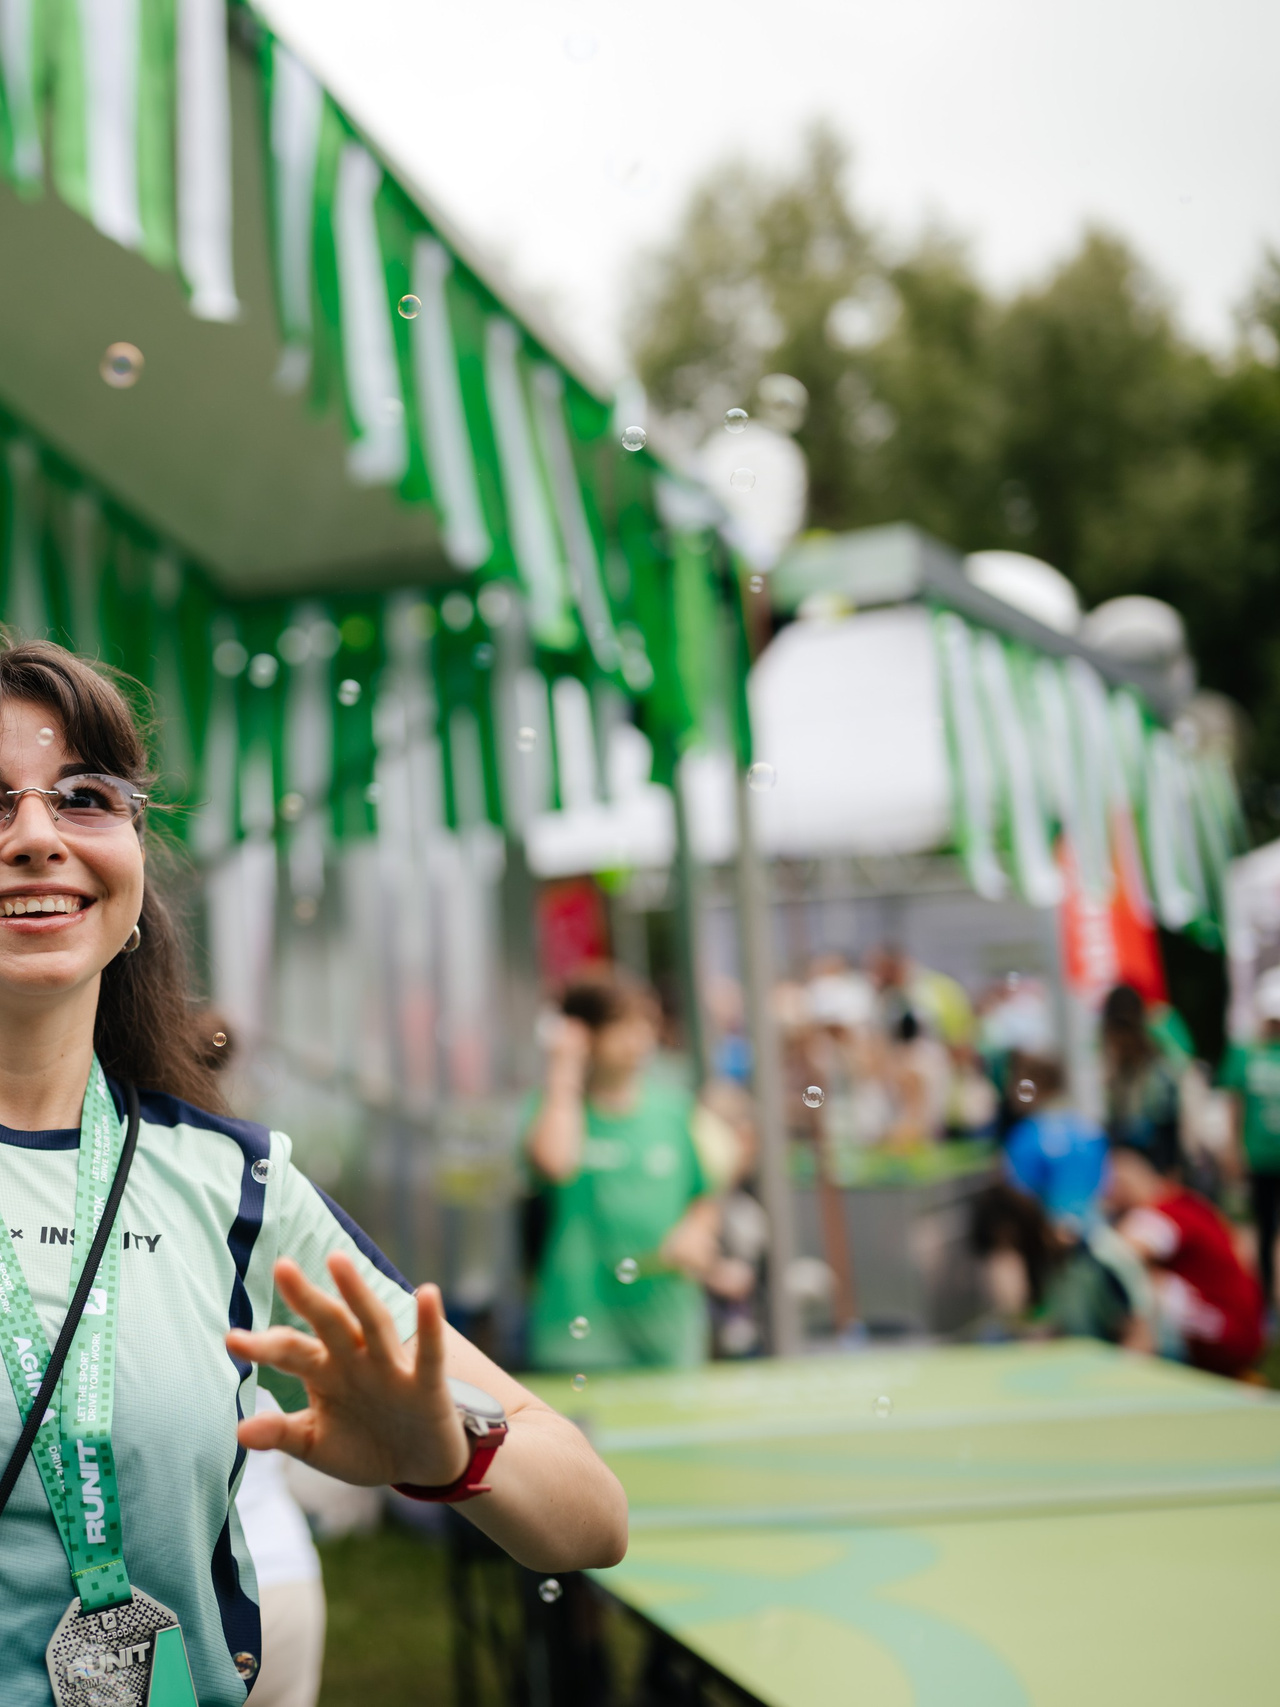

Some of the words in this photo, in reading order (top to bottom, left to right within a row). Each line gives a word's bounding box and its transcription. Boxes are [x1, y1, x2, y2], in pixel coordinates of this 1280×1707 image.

[94, 1124, 103, 1148] SPORT
[102, 1114, 110, 1135] WORK
[93, 1148, 101, 1165] THE
[102, 1135, 111, 1157] YOUR
[91, 1165, 100, 1180] LET
[100, 1158, 110, 1183] DRIVE
[91, 1332, 101, 1362] WORK
[79, 1351, 89, 1382] SPORT
[89, 1363, 100, 1389] YOUR
[78, 1383, 87, 1403] THE
[77, 1405, 86, 1422] LET
[88, 1391, 98, 1421] DRIVE
[49, 1445, 64, 1477] DRIVE
[76, 1438, 106, 1544] RUNIT
[89, 1626, 134, 1645] Пассворк
[67, 1642, 151, 1684] RUNIT
